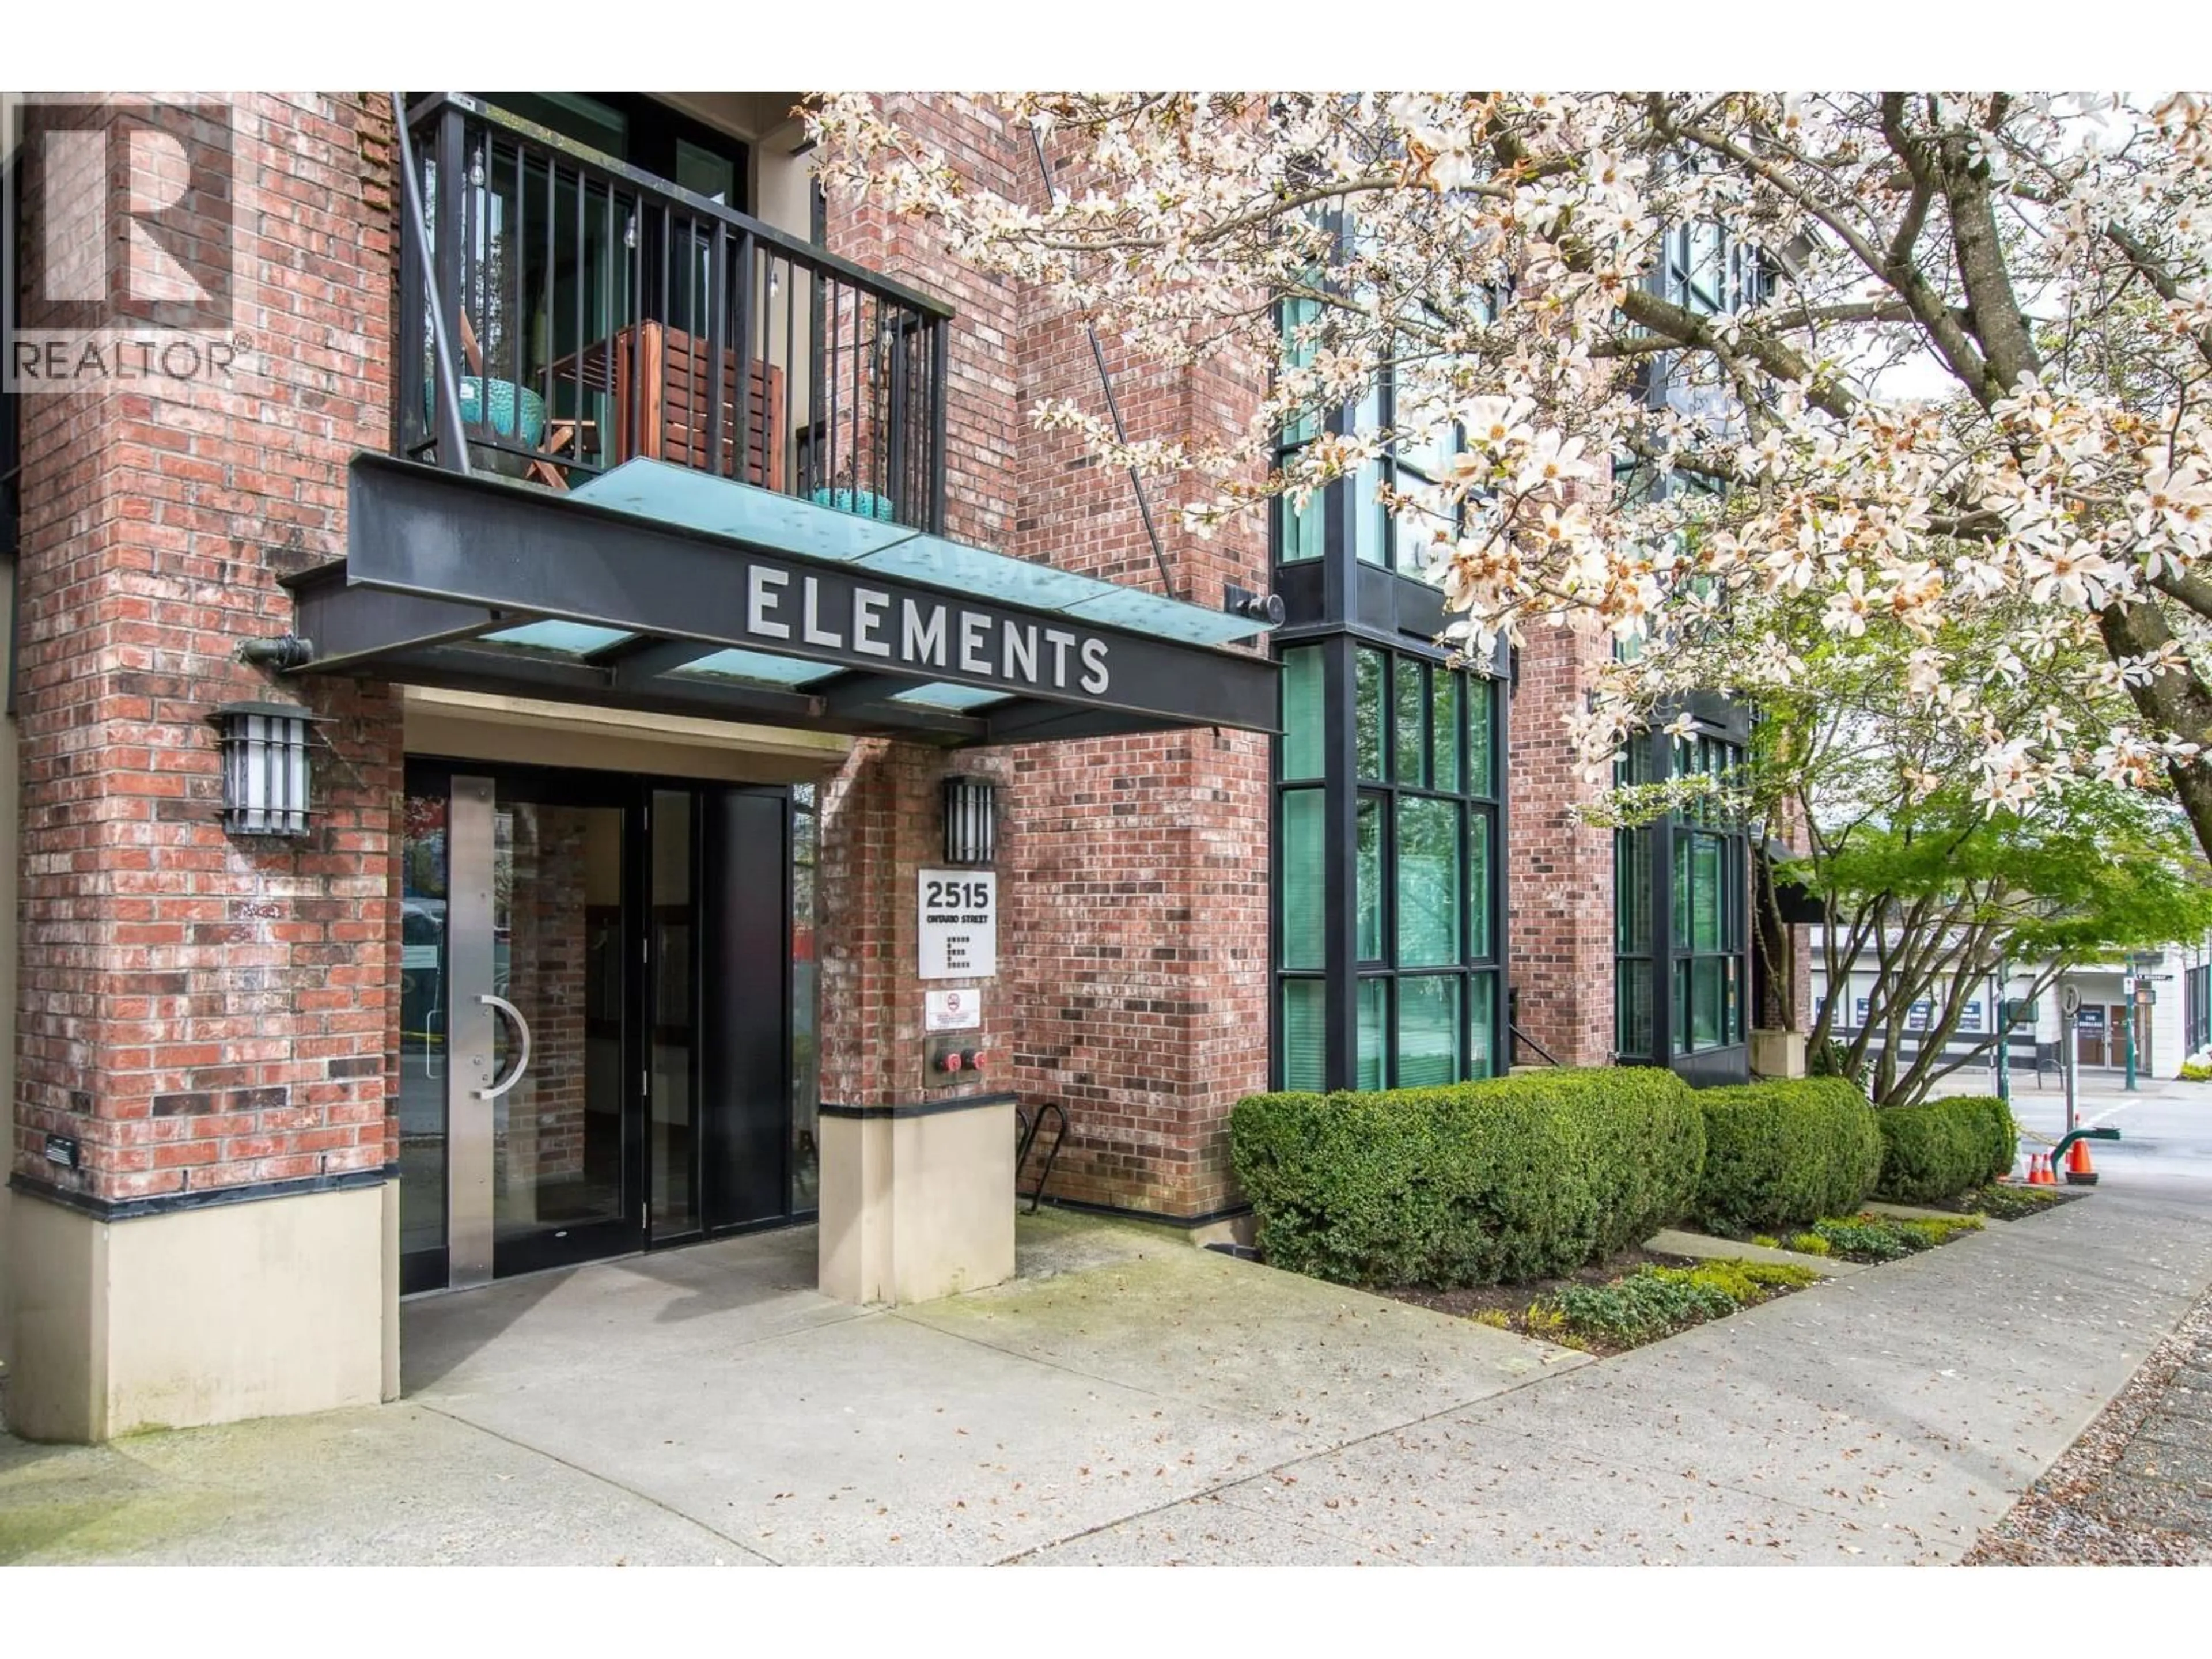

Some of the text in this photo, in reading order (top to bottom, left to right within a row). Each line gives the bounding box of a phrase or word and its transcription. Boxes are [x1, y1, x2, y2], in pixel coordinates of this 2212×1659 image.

[747, 564, 1109, 695] ELEMENTS
[927, 881, 988, 908] 2515
[961, 915, 988, 924] STREET
